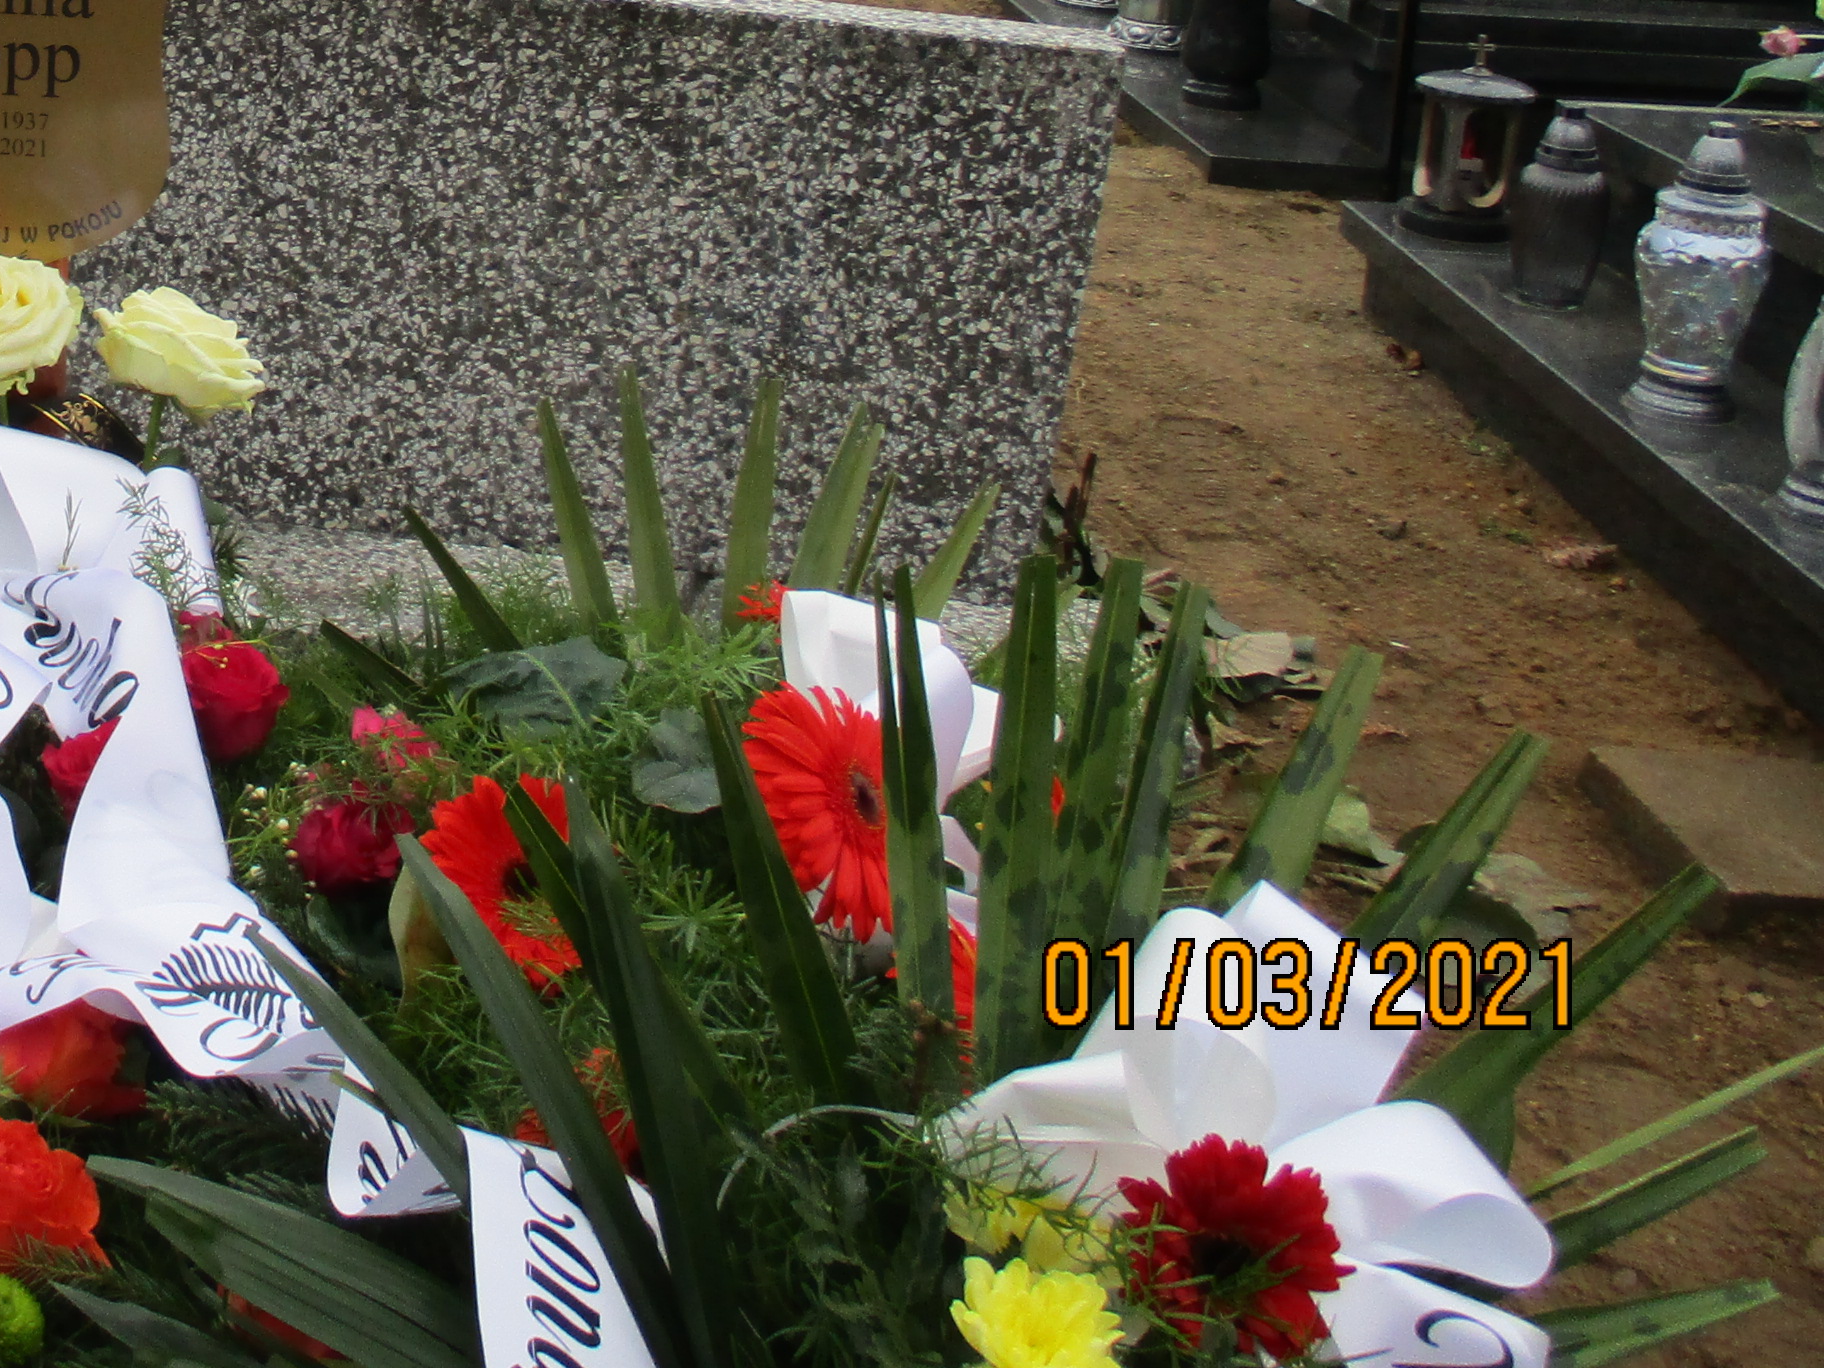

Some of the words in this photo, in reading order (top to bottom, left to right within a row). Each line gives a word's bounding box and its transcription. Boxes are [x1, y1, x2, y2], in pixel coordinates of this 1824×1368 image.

[1, 110, 49, 130] 1937
[0, 137, 47, 158] 2021
[20, 226, 38, 243] W
[47, 200, 124, 242] POKOJU
